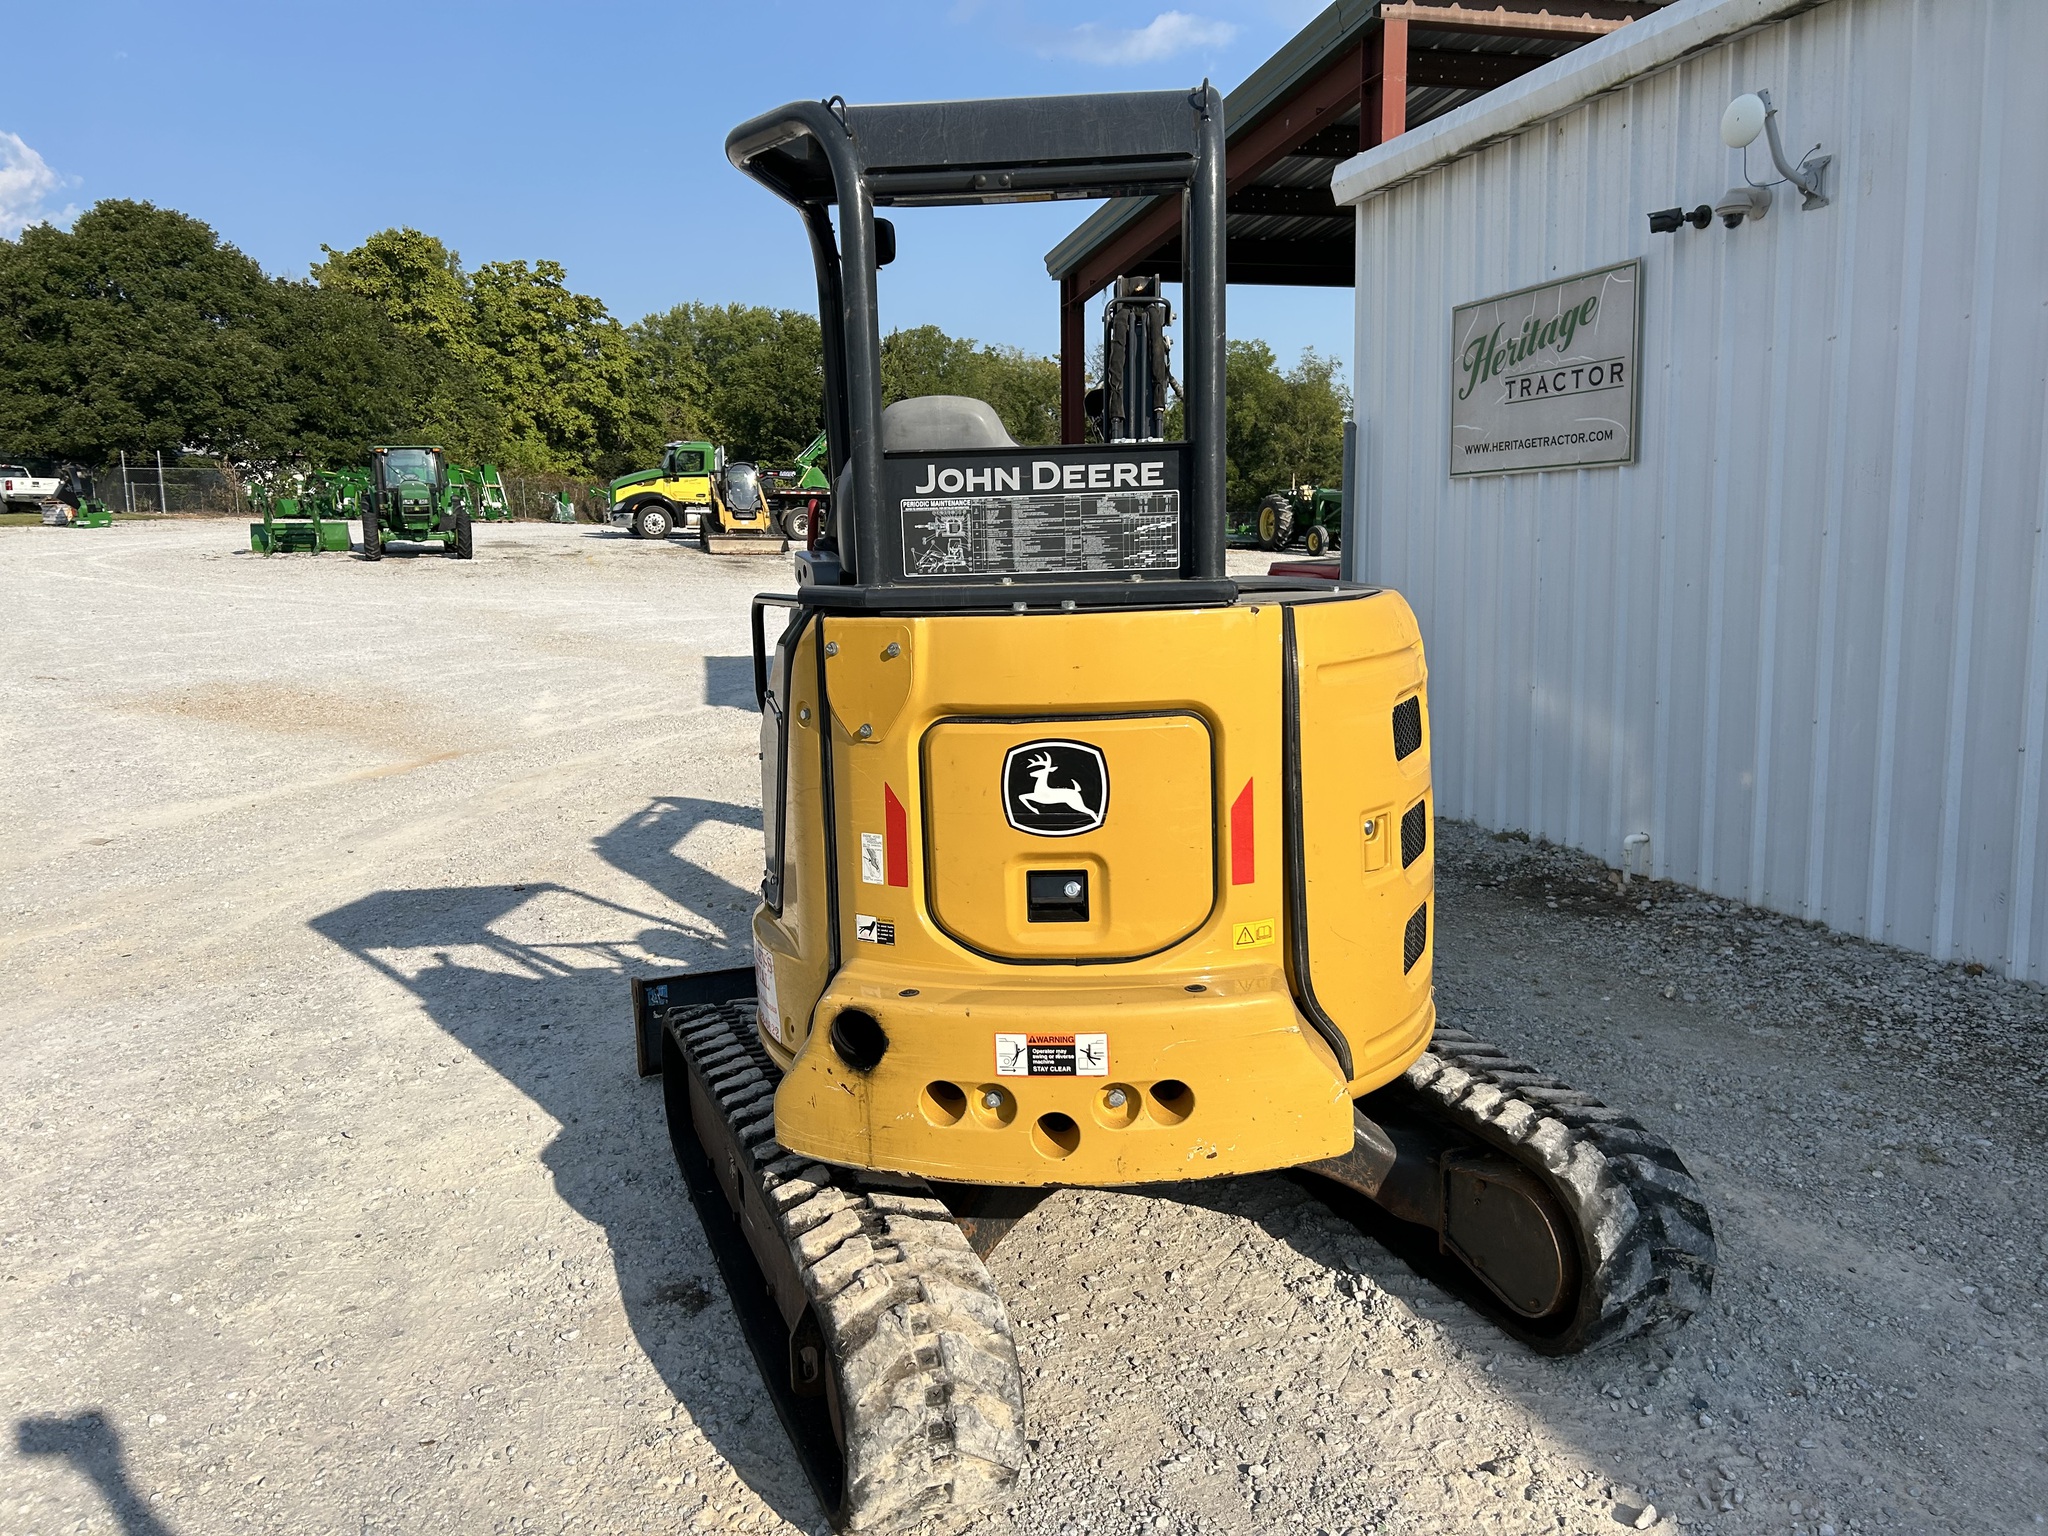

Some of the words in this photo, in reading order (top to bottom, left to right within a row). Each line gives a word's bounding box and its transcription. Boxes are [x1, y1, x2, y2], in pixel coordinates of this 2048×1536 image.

[1458, 296, 1598, 400] Heritage
[1505, 362, 1624, 399] TRACTOR
[1465, 430, 1613, 455] WWW.HERITAGETRACTOR.COM
[915, 464, 1020, 494] JOHN
[1032, 461, 1164, 490] DEERE
[930, 499, 971, 507] MAINTENANCE
